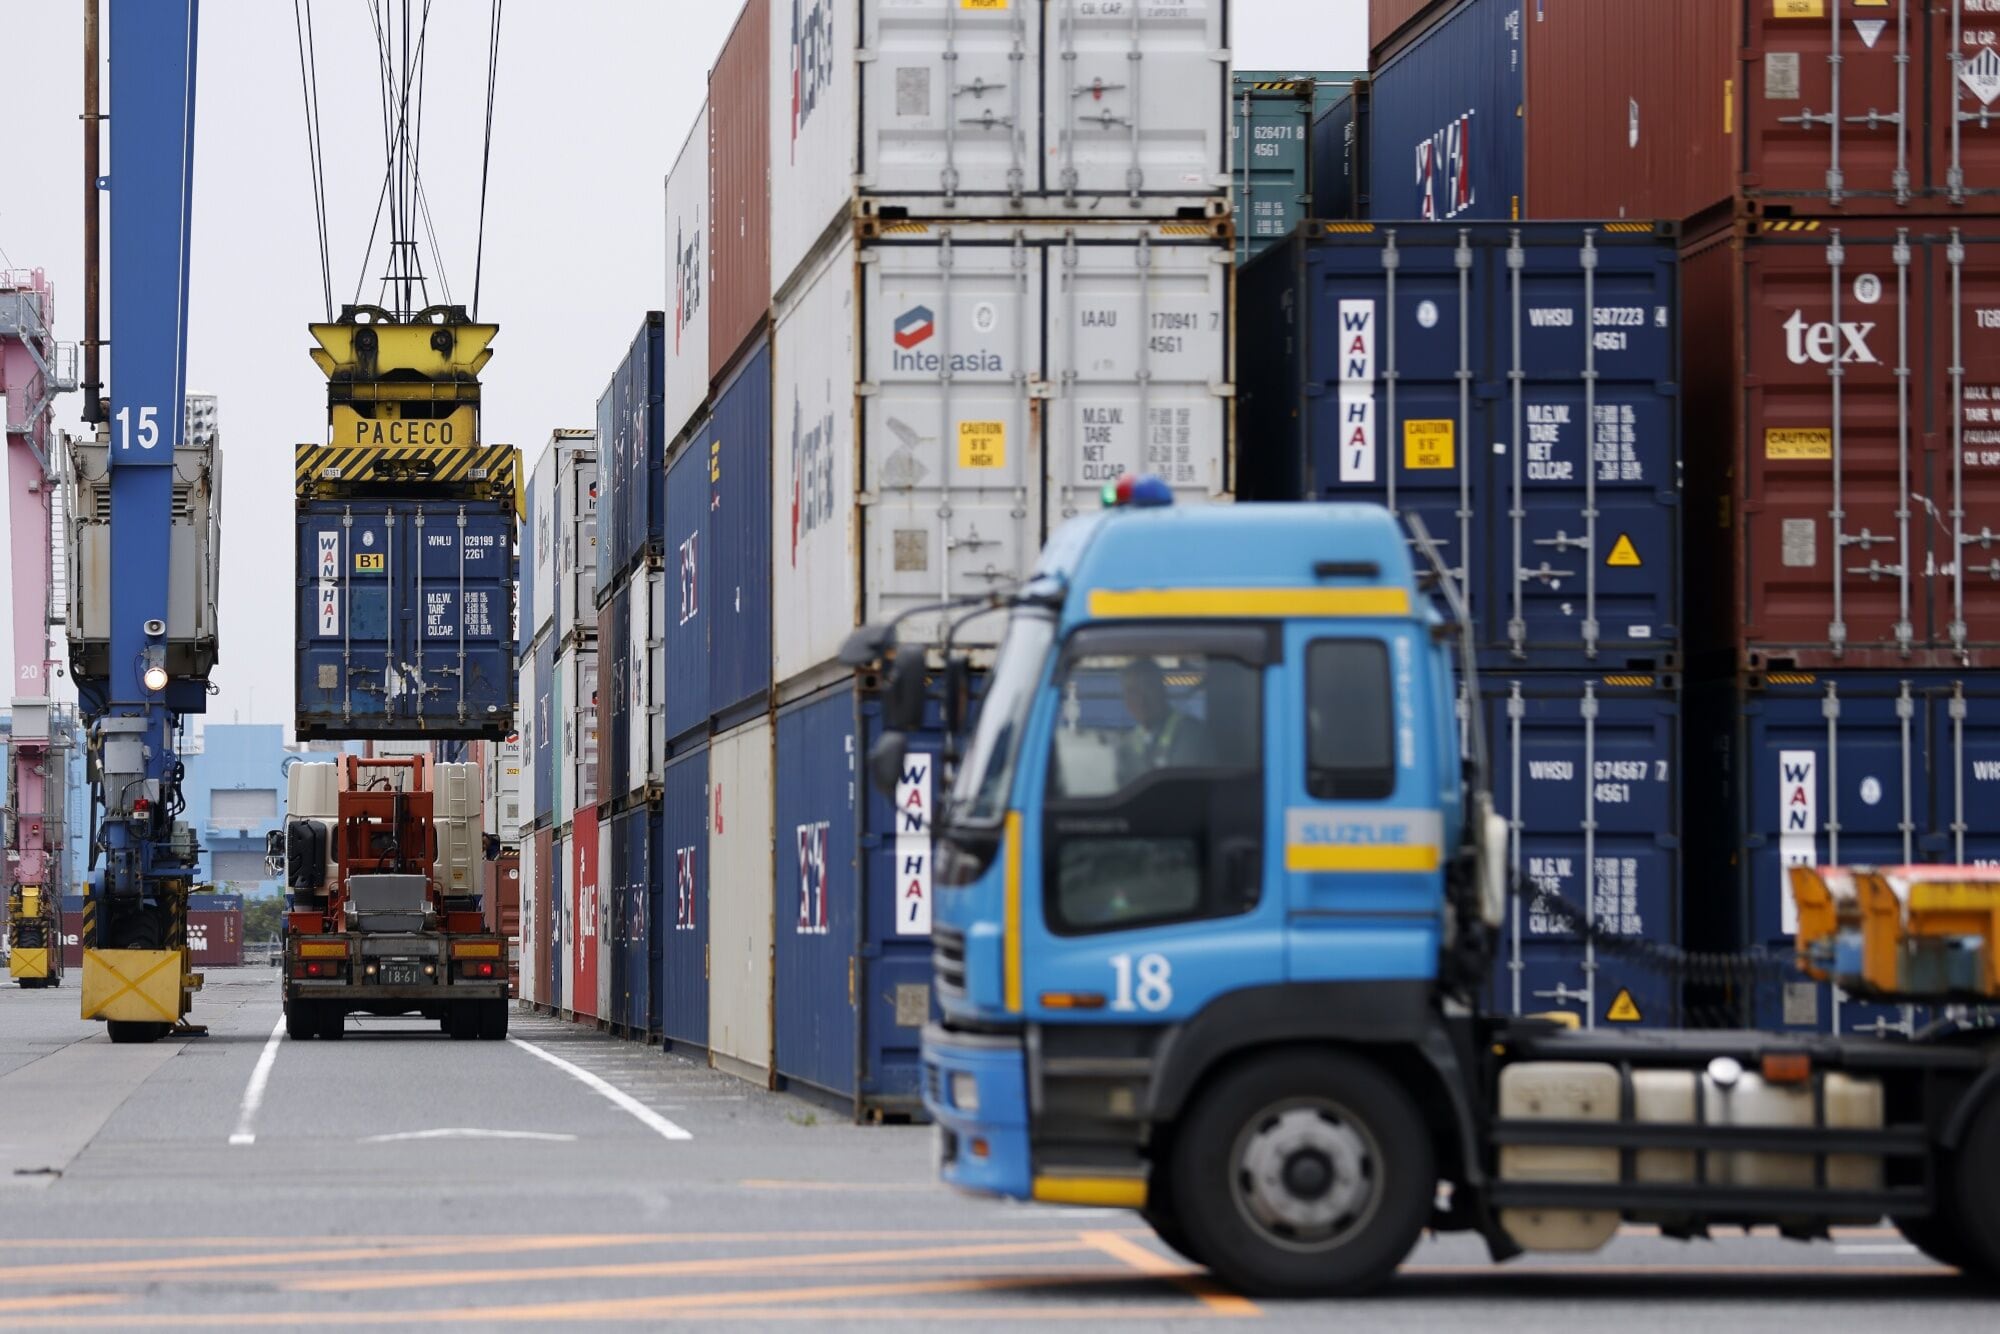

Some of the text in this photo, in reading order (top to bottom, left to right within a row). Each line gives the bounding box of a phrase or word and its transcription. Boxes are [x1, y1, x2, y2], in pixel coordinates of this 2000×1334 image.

[1254, 126, 1292, 139] 626471
[1082, 310, 1116, 327] IAAU
[1151, 312, 1198, 329] 170941
[1782, 308, 1877, 365] tex
[1343, 312, 1369, 469] WAN HAI
[116, 406, 159, 449] 15
[356, 421, 453, 445] PACECO
[1084, 426, 1112, 443] TARE
[1083, 445, 1105, 461] NET
[428, 535, 506, 546] WHLU 029199 3
[359, 554, 380, 568] B1
[320, 537, 336, 629] WAN HAI
[428, 604, 446, 615] TARE
[427, 615, 441, 625] NET
[21, 664, 38, 679] 20
[1785, 763, 1810, 829] WAN
[901, 765, 926, 922] WAN HAI
[1107, 952, 1173, 1012] 18
